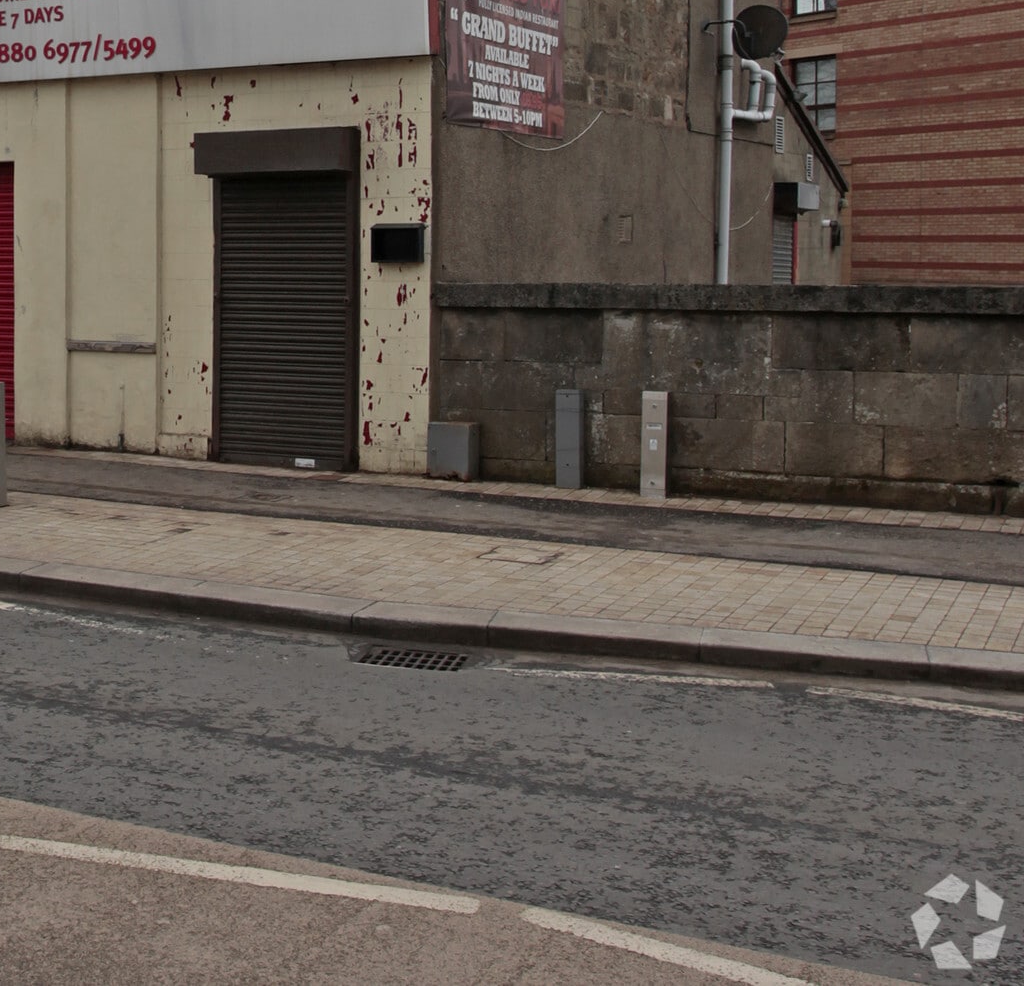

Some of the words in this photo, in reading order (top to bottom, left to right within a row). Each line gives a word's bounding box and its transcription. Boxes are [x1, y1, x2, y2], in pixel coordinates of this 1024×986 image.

[11, 13, 19, 30] 7
[25, 6, 65, 25] DAYS
[492, 1, 514, 17] LICENSED
[461, 11, 506, 44] GRAND
[43, 34, 157, 65] 6977/5499
[485, 44, 530, 70] AVAILABLE
[468, 60, 474, 78] 7
[475, 61, 511, 86] NIGHTS
[512, 70, 519, 87] A
[520, 72, 545, 93] WEEK
[472, 81, 499, 102] FROM
[499, 87, 521, 106] ONLY
[472, 101, 513, 123] BETWEEN
[514, 108, 543, 128] 5-10PM
